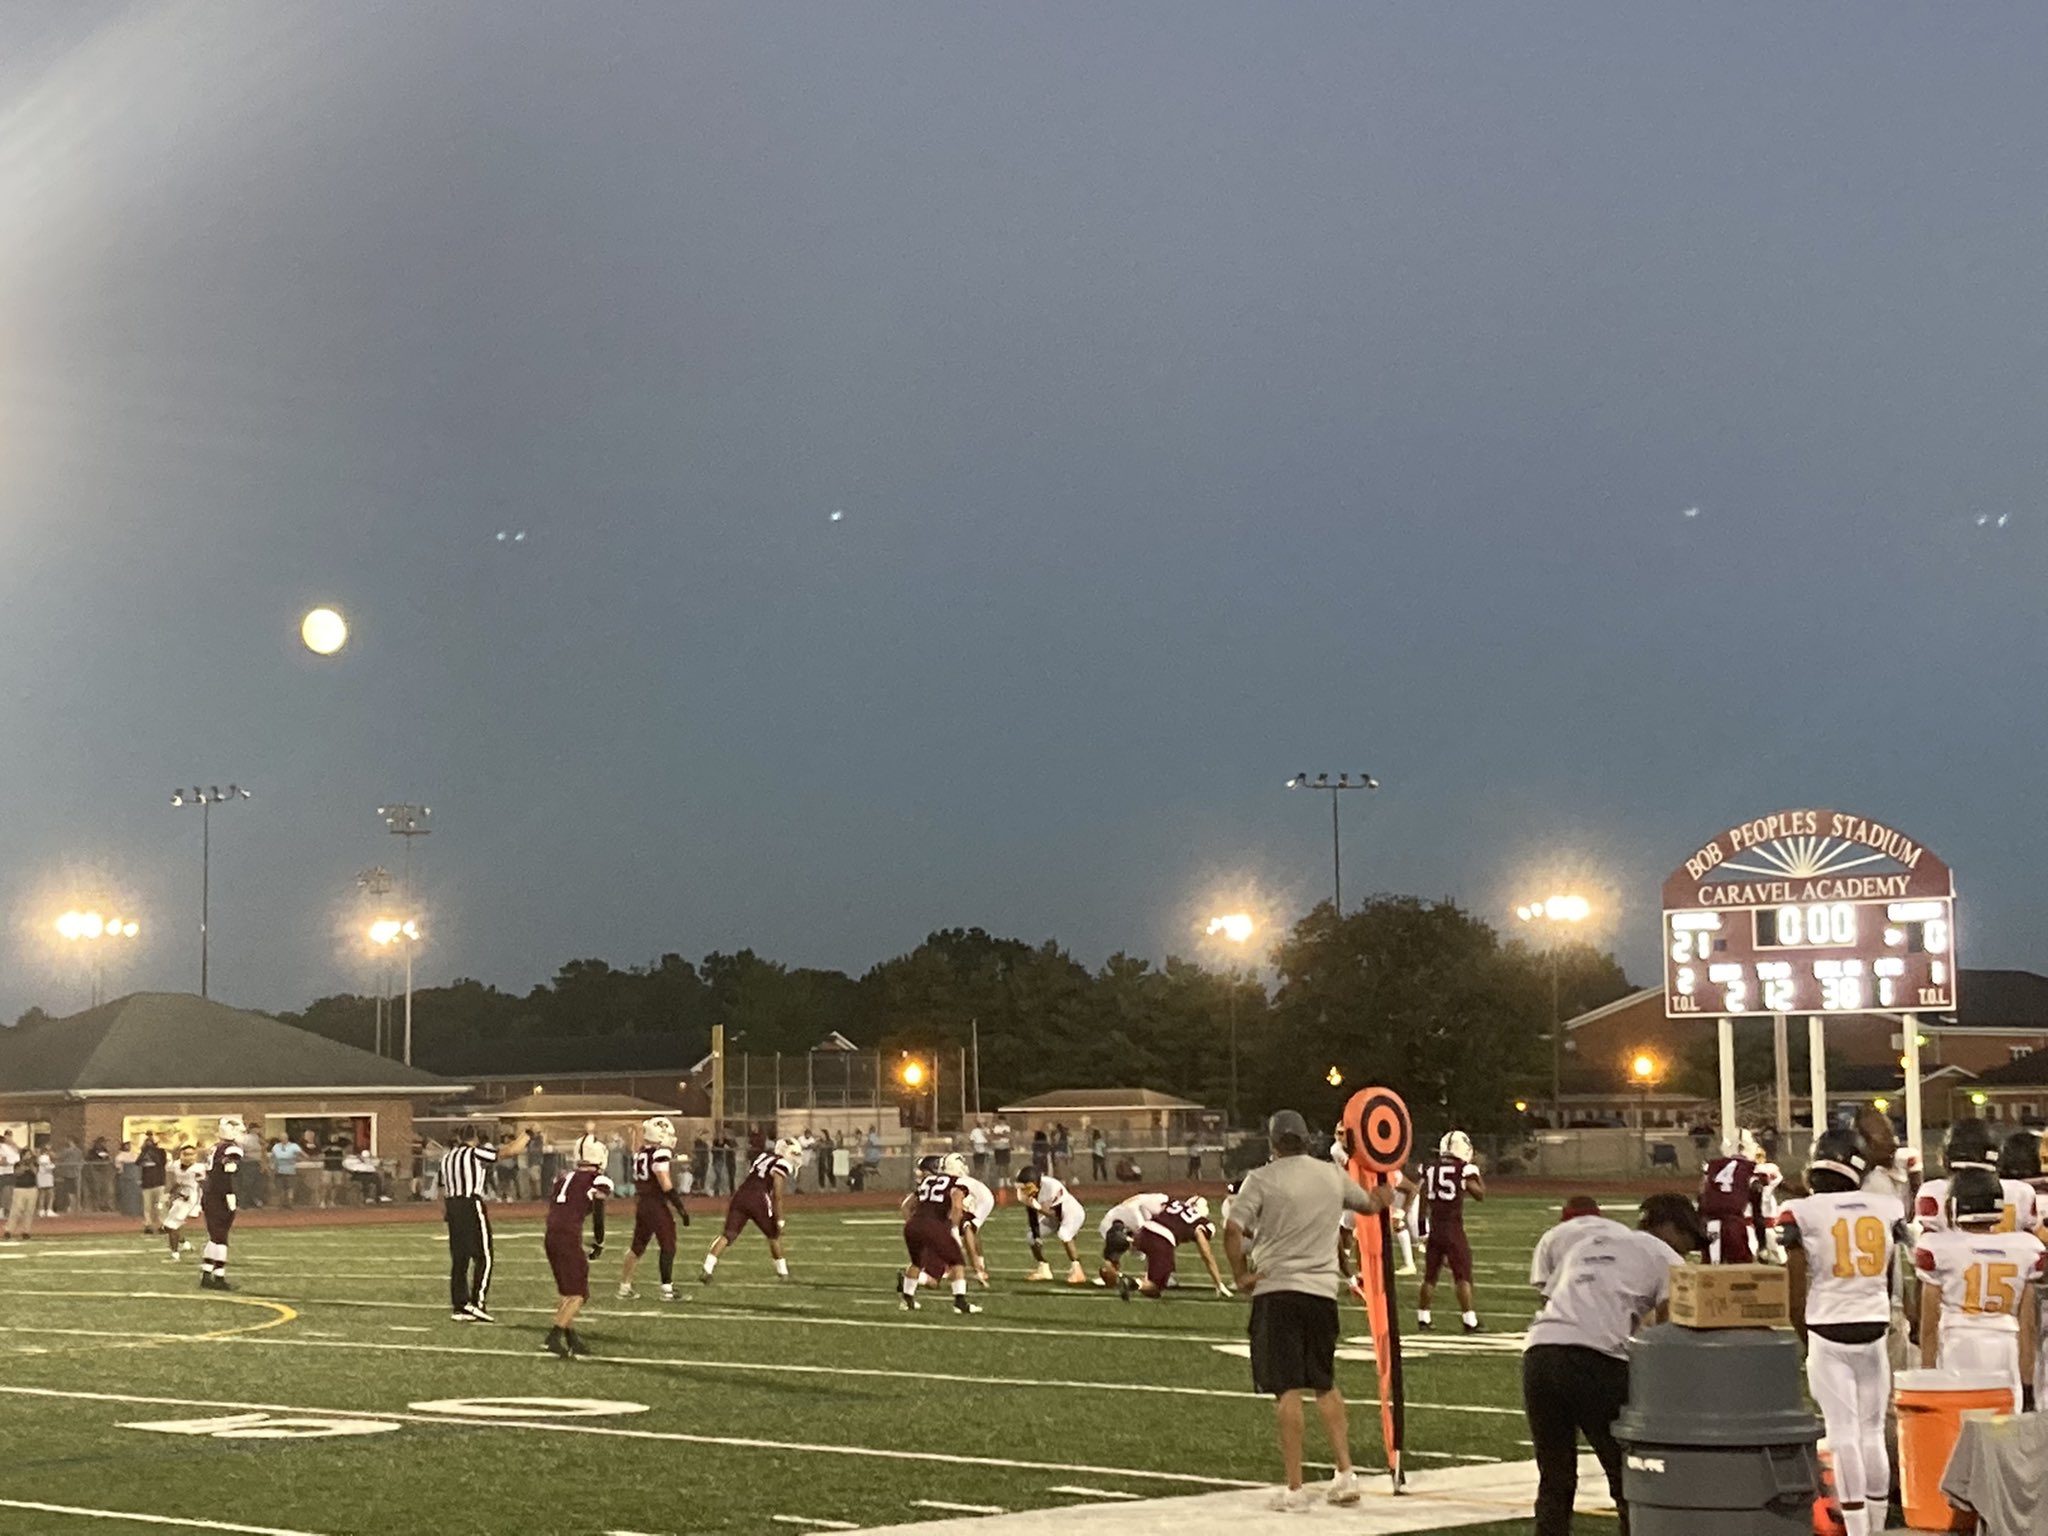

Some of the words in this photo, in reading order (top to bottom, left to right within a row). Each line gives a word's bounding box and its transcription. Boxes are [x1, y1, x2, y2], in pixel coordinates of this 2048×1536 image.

[1685, 841, 1723, 880] BOB
[1729, 811, 1817, 852] PEOPLES
[1832, 813, 1923, 869] STADIUM
[1698, 882, 1798, 906] CARAVEL
[1801, 876, 1911, 899] ACADEMY
[918, 1175, 951, 1203] 52
[1427, 1165, 1456, 1201] 15
[1715, 1160, 1738, 1193] 4
[1831, 1216, 1886, 1279] 19
[1963, 1263, 2018, 1314] 15
